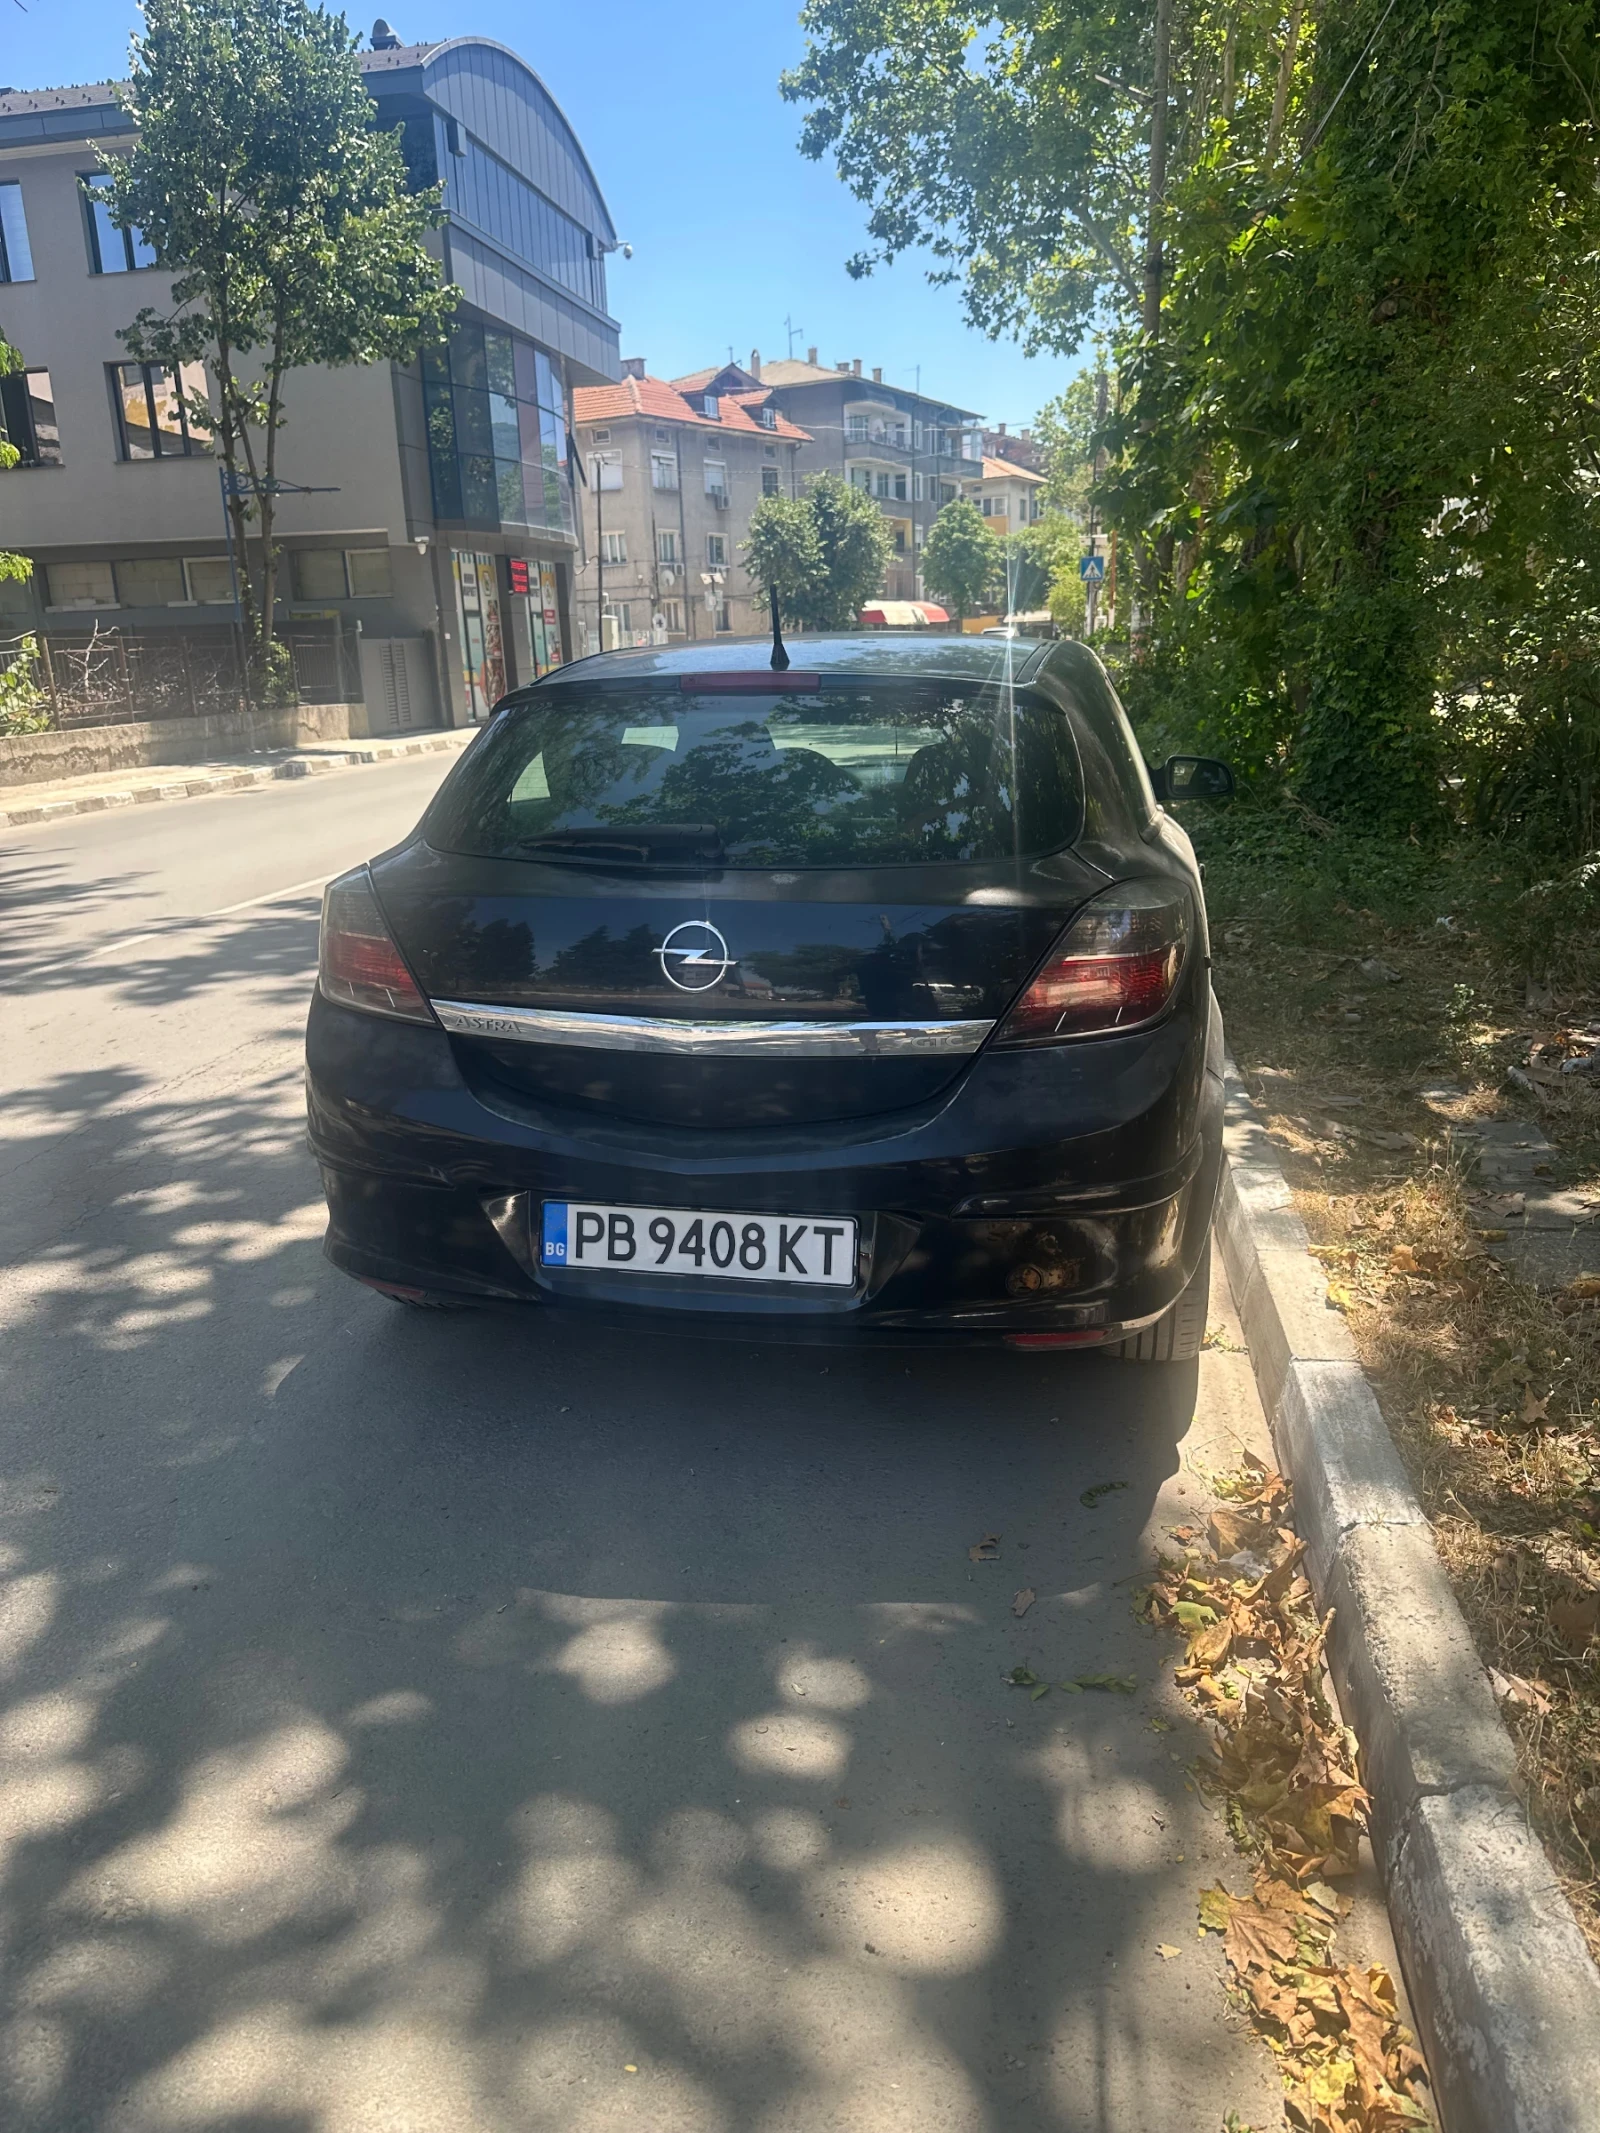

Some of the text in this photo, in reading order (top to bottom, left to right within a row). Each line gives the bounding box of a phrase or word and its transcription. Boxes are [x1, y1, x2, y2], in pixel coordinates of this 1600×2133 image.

[456, 1015, 520, 1033] ASTRA
[911, 1035, 963, 1048] GTC
[545, 1241, 566, 1257] BG
[575, 1211, 845, 1276] PB 9408 KT
